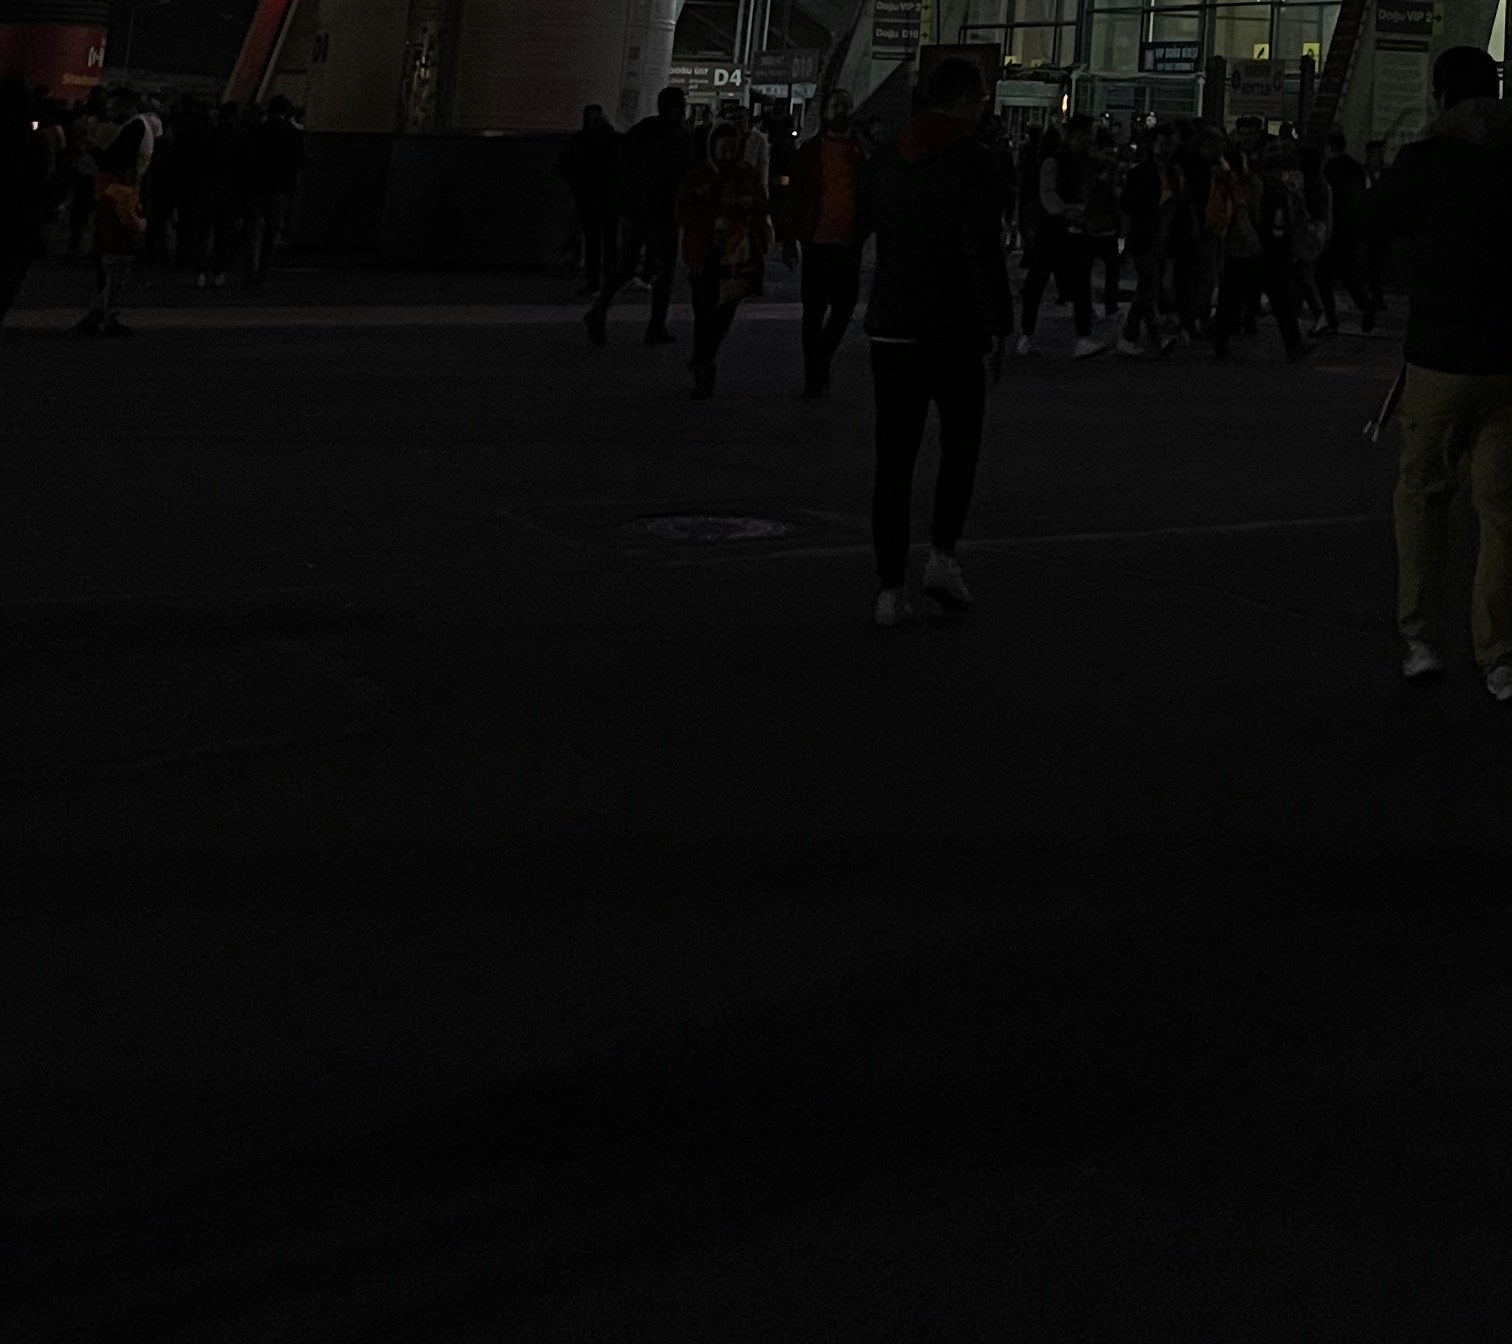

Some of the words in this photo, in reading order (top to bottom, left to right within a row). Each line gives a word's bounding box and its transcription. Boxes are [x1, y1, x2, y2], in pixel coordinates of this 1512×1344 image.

[1406, 10, 1425, 22] VIP
[1425, 11, 1433, 23] 2
[714, 67, 743, 87] D4
